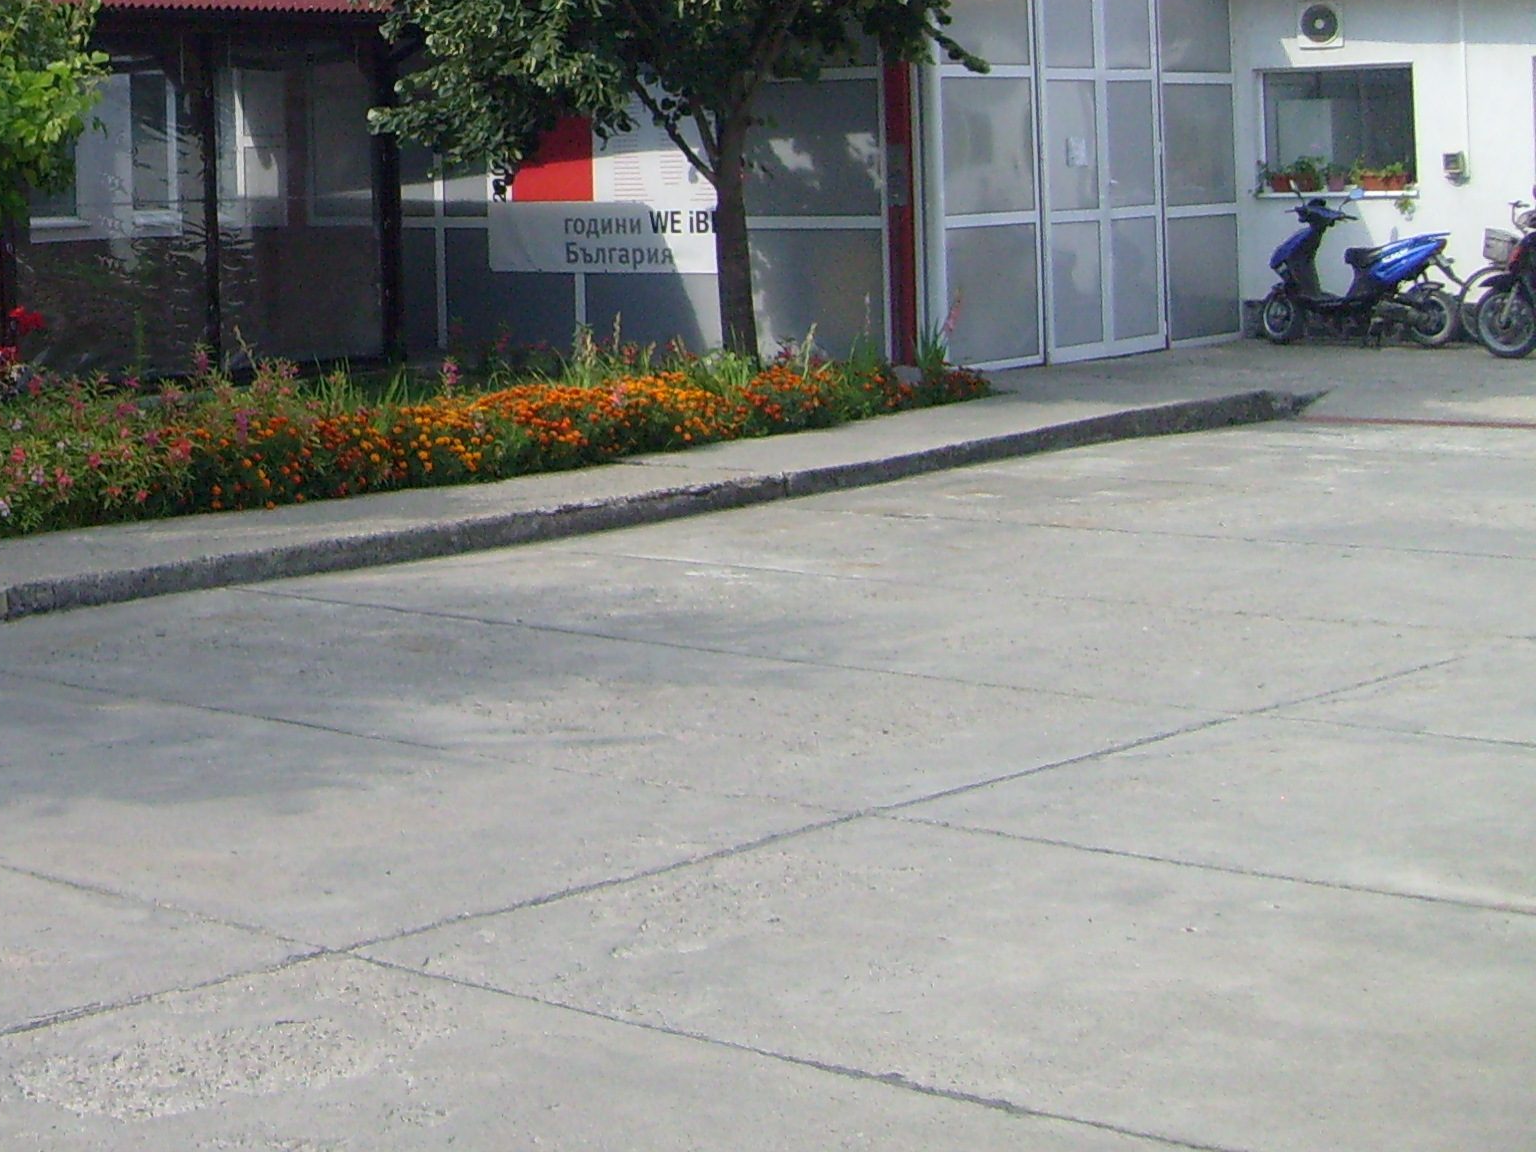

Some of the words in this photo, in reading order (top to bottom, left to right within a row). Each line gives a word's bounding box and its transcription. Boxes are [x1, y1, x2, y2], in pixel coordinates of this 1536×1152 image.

[564, 217, 642, 239] години
[650, 210, 682, 234] WE
[566, 242, 674, 269] България
